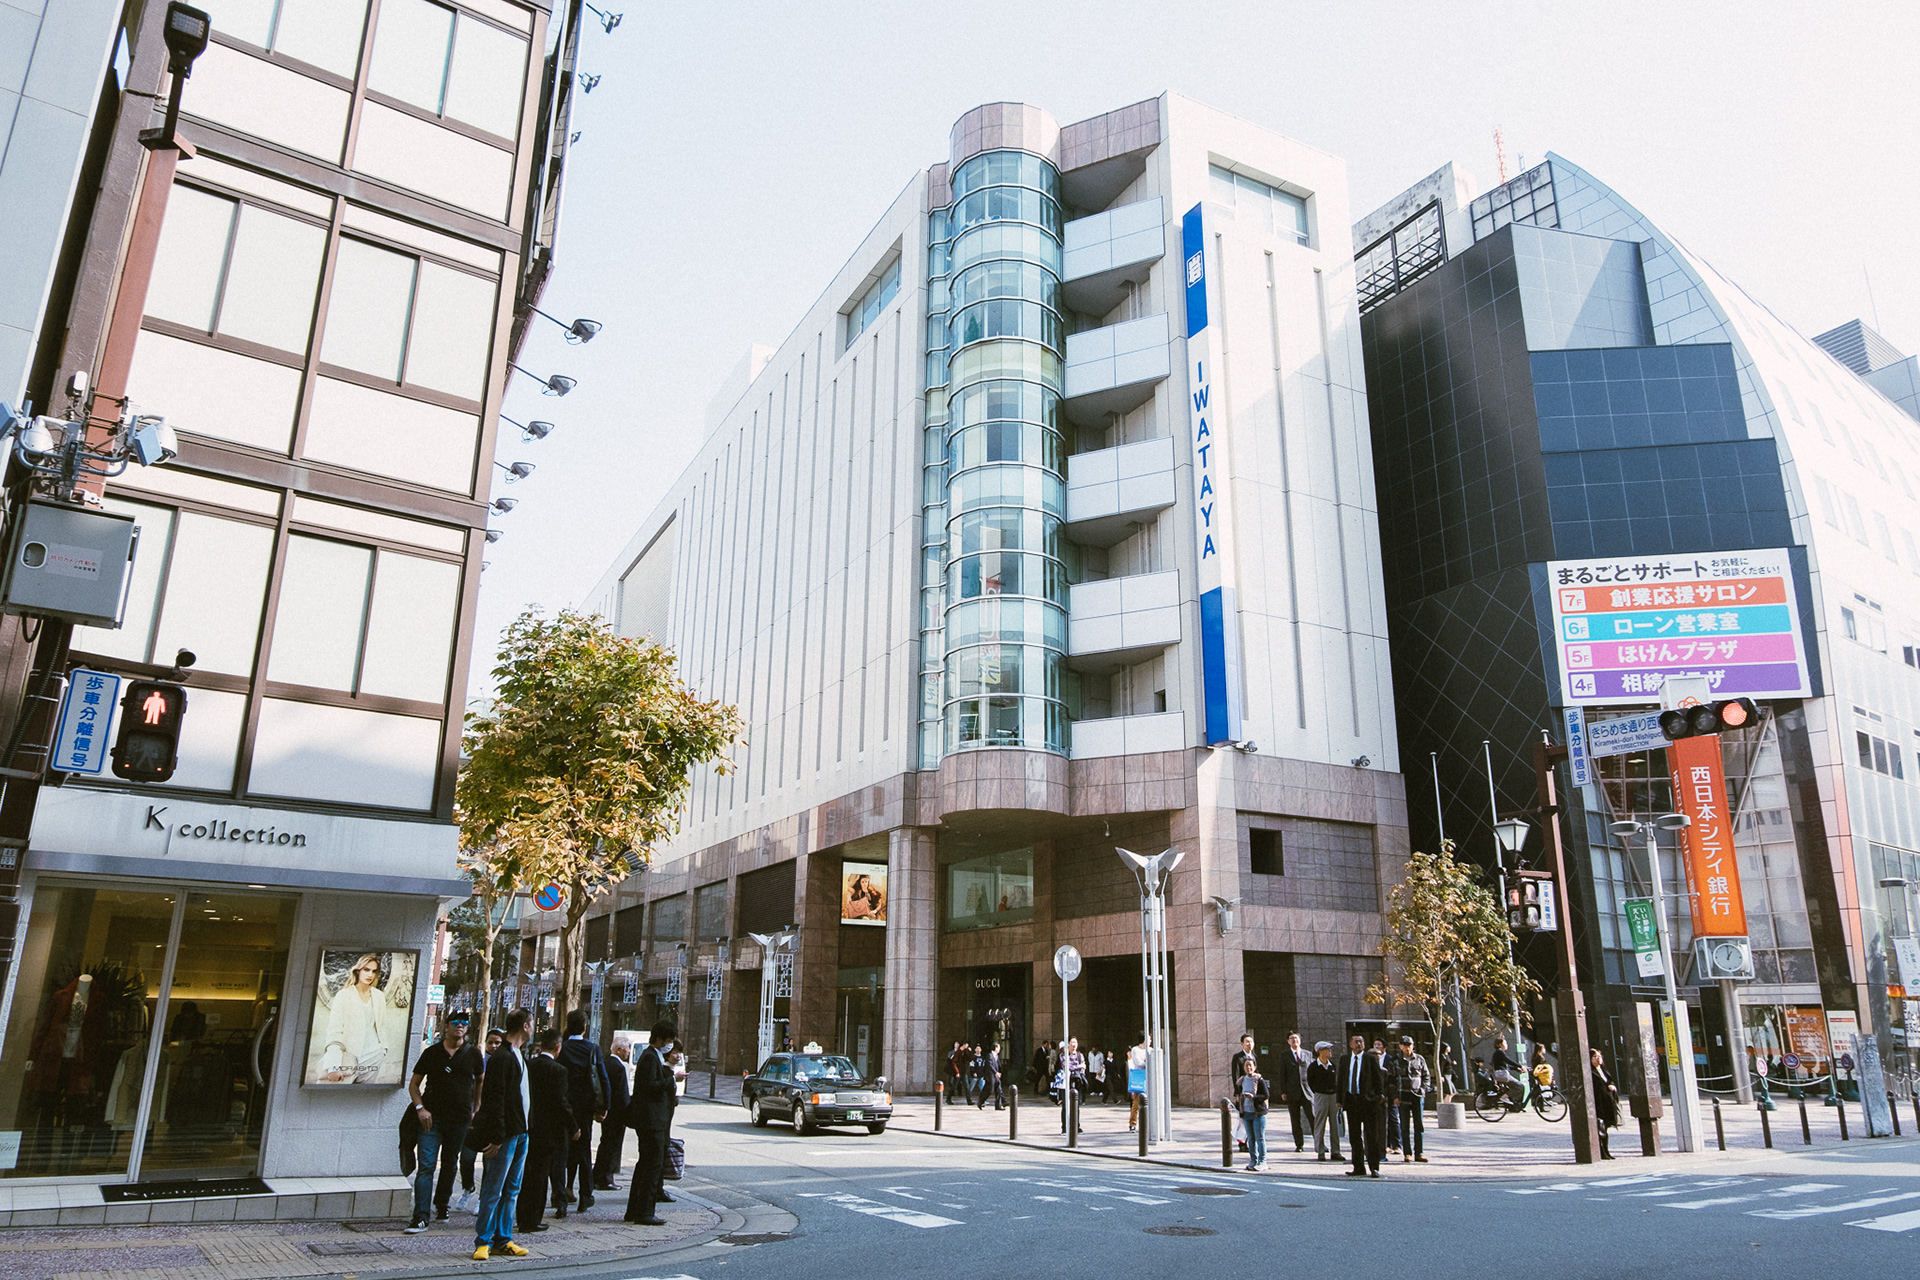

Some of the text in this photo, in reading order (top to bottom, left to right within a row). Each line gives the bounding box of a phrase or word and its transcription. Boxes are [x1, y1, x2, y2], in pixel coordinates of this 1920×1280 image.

[1193, 361, 1216, 559] IWATAYA
[1557, 560, 1708, 585] まるごとサポート
[1711, 557, 1749, 568] お気軽に
[1565, 594, 1582, 607] 7F
[1609, 583, 1758, 608] 創業応援サロン
[1568, 622, 1586, 635] 6F
[1614, 612, 1741, 635] ローン営業室
[1571, 650, 1589, 663] 5F
[1618, 640, 1738, 663] ほけんプラザ
[1575, 679, 1593, 692] 4F
[1621, 669, 1726, 692] 相続ザ
[70, 676, 105, 767] 歩車分離信号
[1568, 712, 1587, 782] 歩車分離信号
[1594, 736, 1633, 747] Kirameki-dori
[1612, 741, 1649, 751] INTERSECTION
[146, 805, 308, 848] K collection
[1690, 766, 1731, 916] 西日本シティ銀行
[975, 978, 1000, 988] GUCCI
